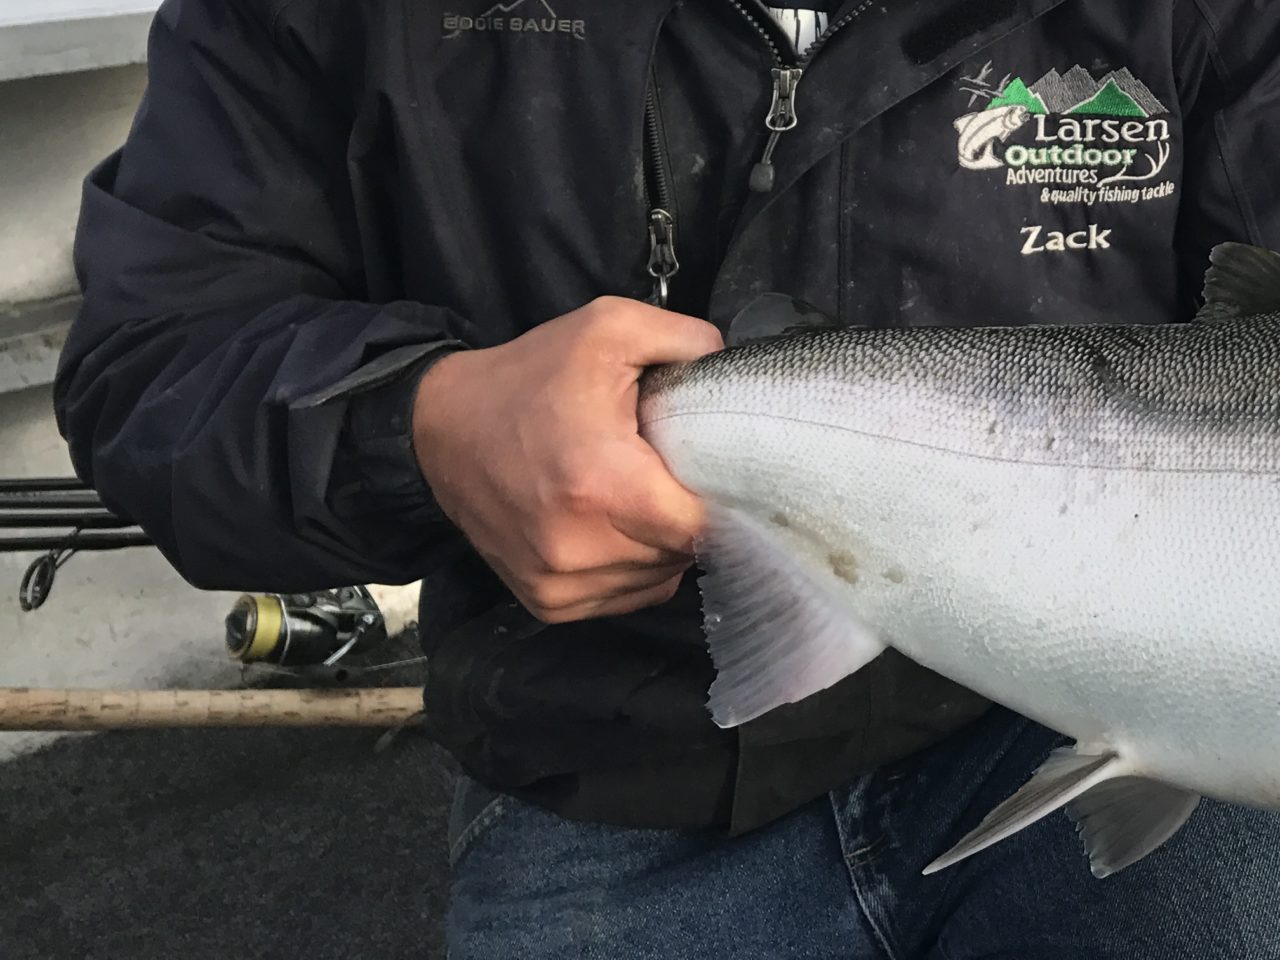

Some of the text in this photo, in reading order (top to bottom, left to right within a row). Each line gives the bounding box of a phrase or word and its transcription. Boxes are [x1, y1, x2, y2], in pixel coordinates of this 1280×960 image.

[509, 16, 586, 34] BAUER
[1033, 113, 1170, 142] Larsen
[1004, 143, 1137, 167] Outdoor
[1006, 167, 1098, 185] Adventures
[1040, 180, 1175, 205] & quality fishing tackle
[1020, 223, 1112, 254] Zack
